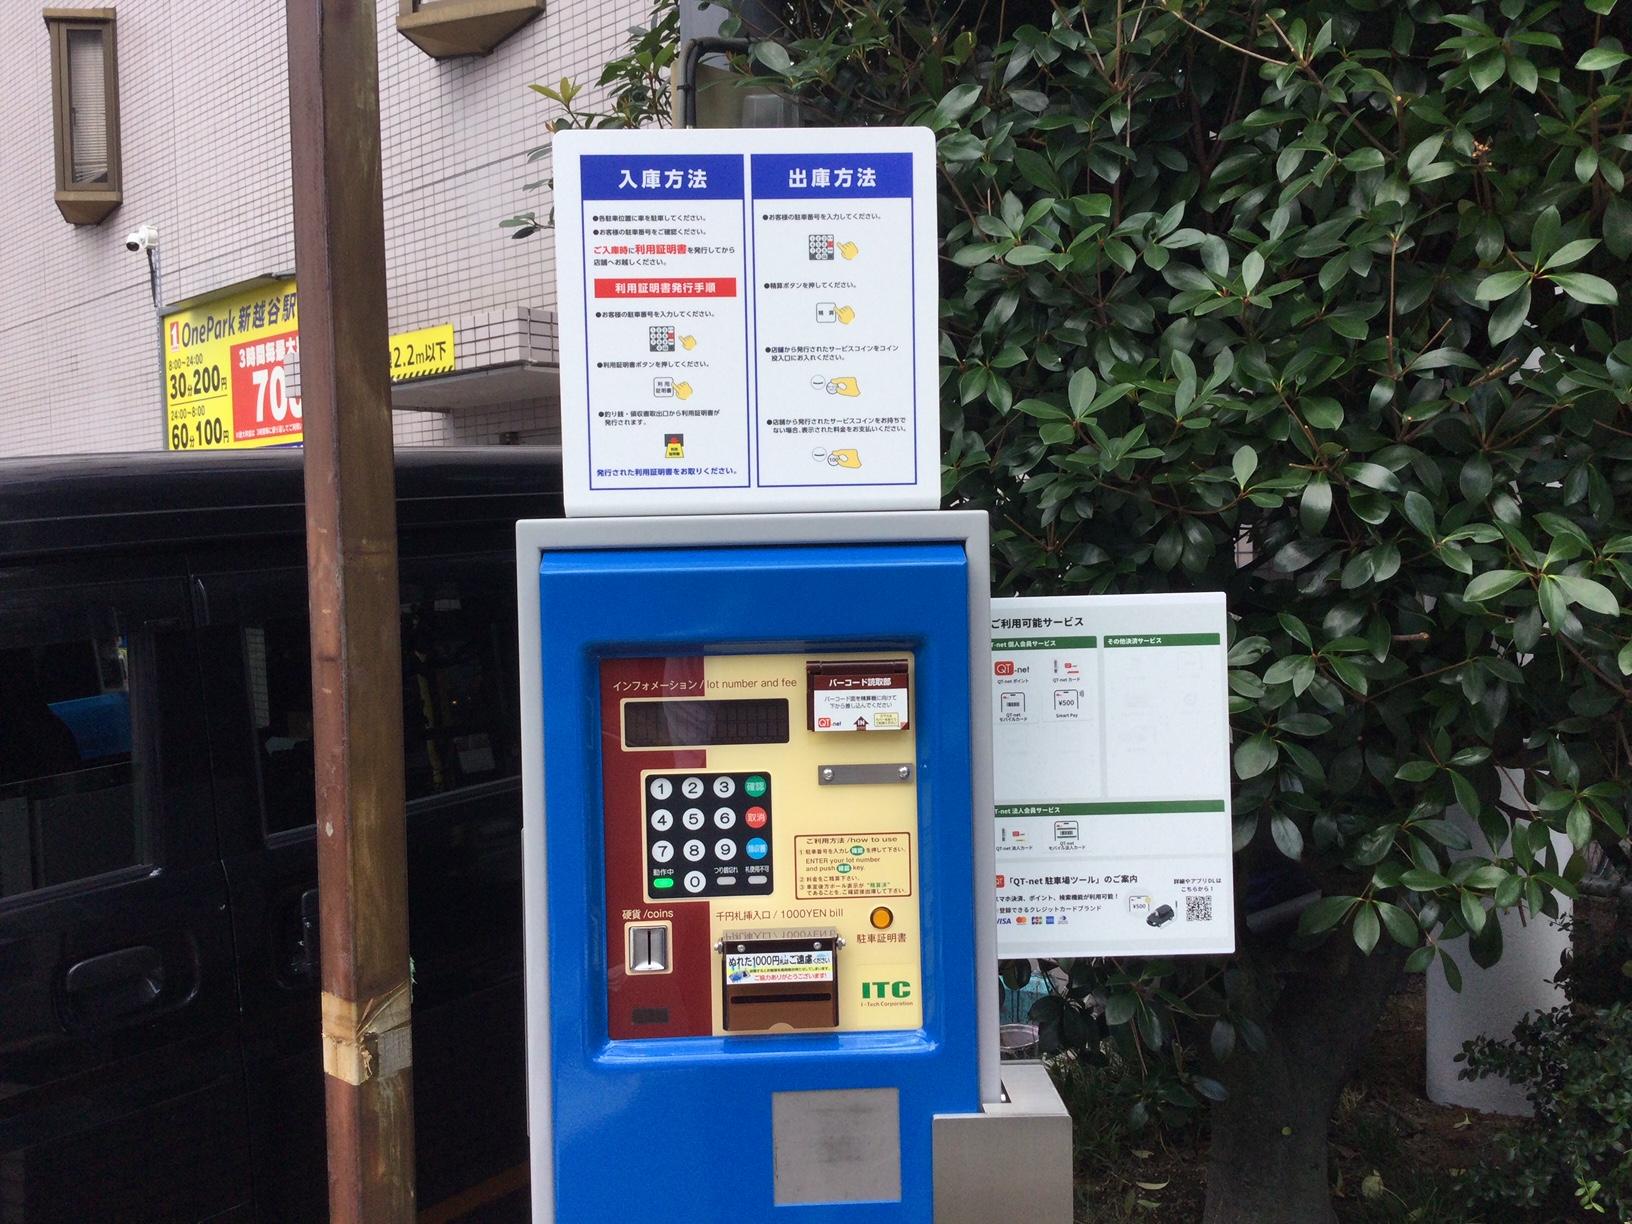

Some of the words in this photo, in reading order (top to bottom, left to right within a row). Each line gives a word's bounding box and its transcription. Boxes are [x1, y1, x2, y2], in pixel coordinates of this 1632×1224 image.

[618, 169, 707, 189] 入庫方法
[789, 168, 877, 188] 出庫方法
[615, 282, 716, 294] 利用証明書発行手順
[182, 309, 236, 348] OnePark
[238, 293, 297, 333] 新越谷駅
[390, 341, 446, 368] 2.2m以下
[992, 617, 1084, 629] ご利用可能サービス
[613, 680, 698, 691] インフォメーション
[707, 680, 719, 689] lot
[722, 679, 758, 688] number
[760, 678, 779, 688] and
[781, 678, 797, 687] fee
[658, 784, 664, 794] 1
[688, 782, 698, 794] 2
[720, 782, 729, 792] 3
[657, 814, 667, 826] 4
[688, 814, 698, 824] 5
[720, 813, 730, 824] 6
[658, 846, 668, 857] 7
[690, 844, 700, 856] 8
[720, 844, 730, 855] 9
[690, 876, 700, 888] 0
[622, 910, 642, 920] 硬貨
[716, 911, 771, 922] 千円札挿入口
[781, 910, 827, 919] 1000YEN
[829, 908, 844, 918] bill
[856, 932, 907, 944] 駐車証明書
[862, 981, 911, 999] ITC
